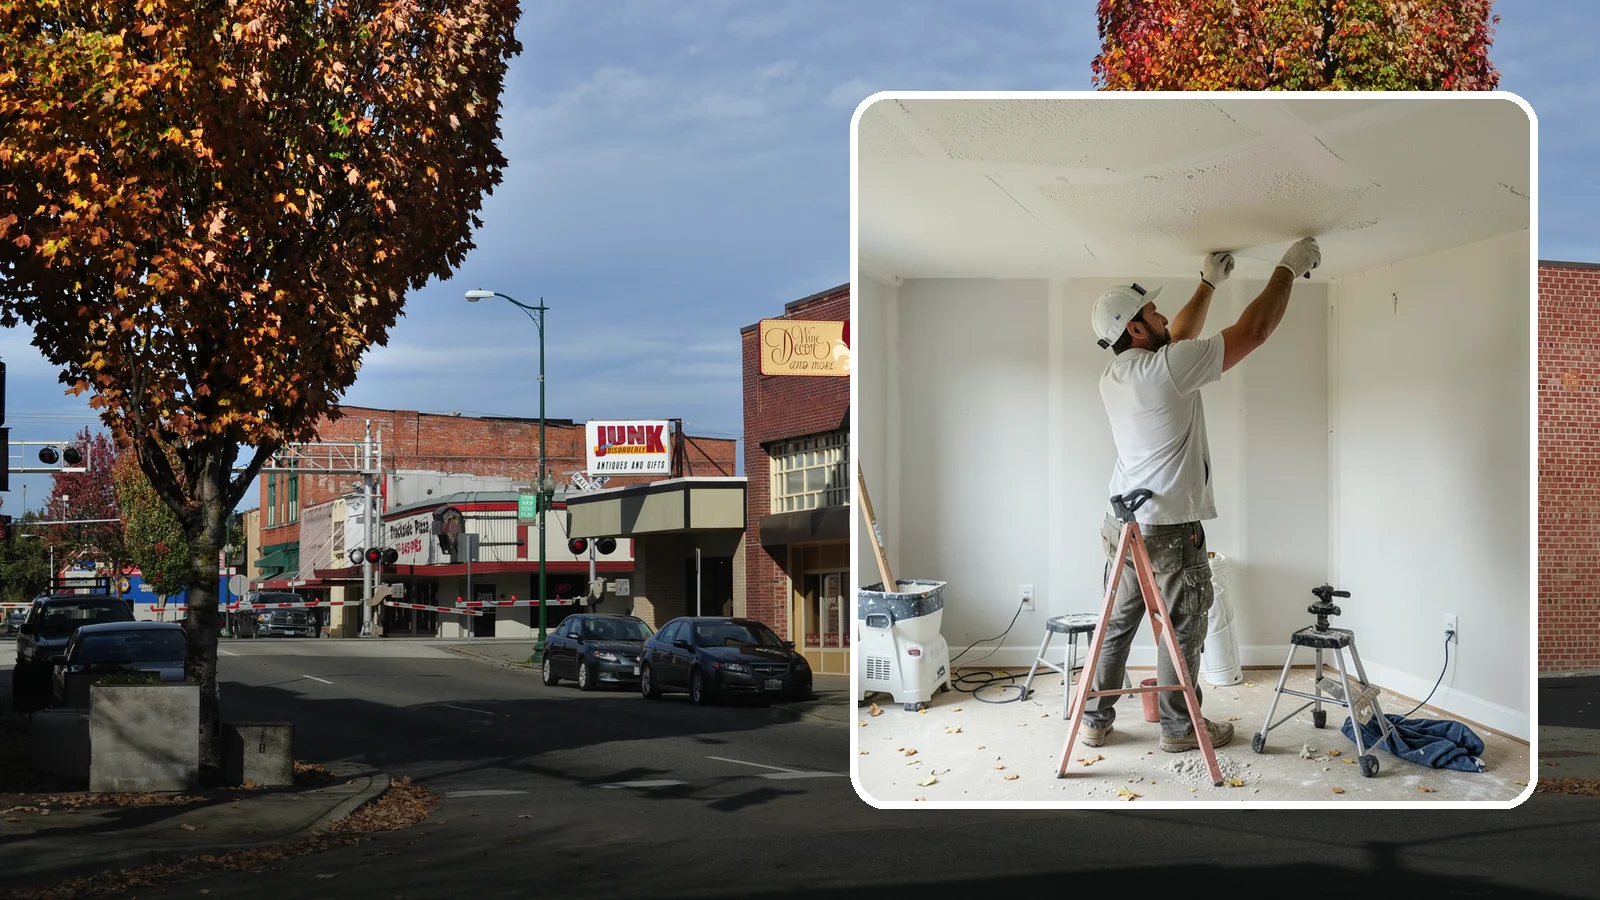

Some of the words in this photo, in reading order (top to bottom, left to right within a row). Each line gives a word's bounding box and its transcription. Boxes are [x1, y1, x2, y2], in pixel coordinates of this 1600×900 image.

[595, 425, 664, 457] JUNK
[607, 446, 646, 454] DISORDERLY
[597, 461, 628, 470] ANTIQUES
[631, 461, 644, 470] AND
[647, 460, 665, 470] GIFTS
[414, 519, 429, 535] Pizza
